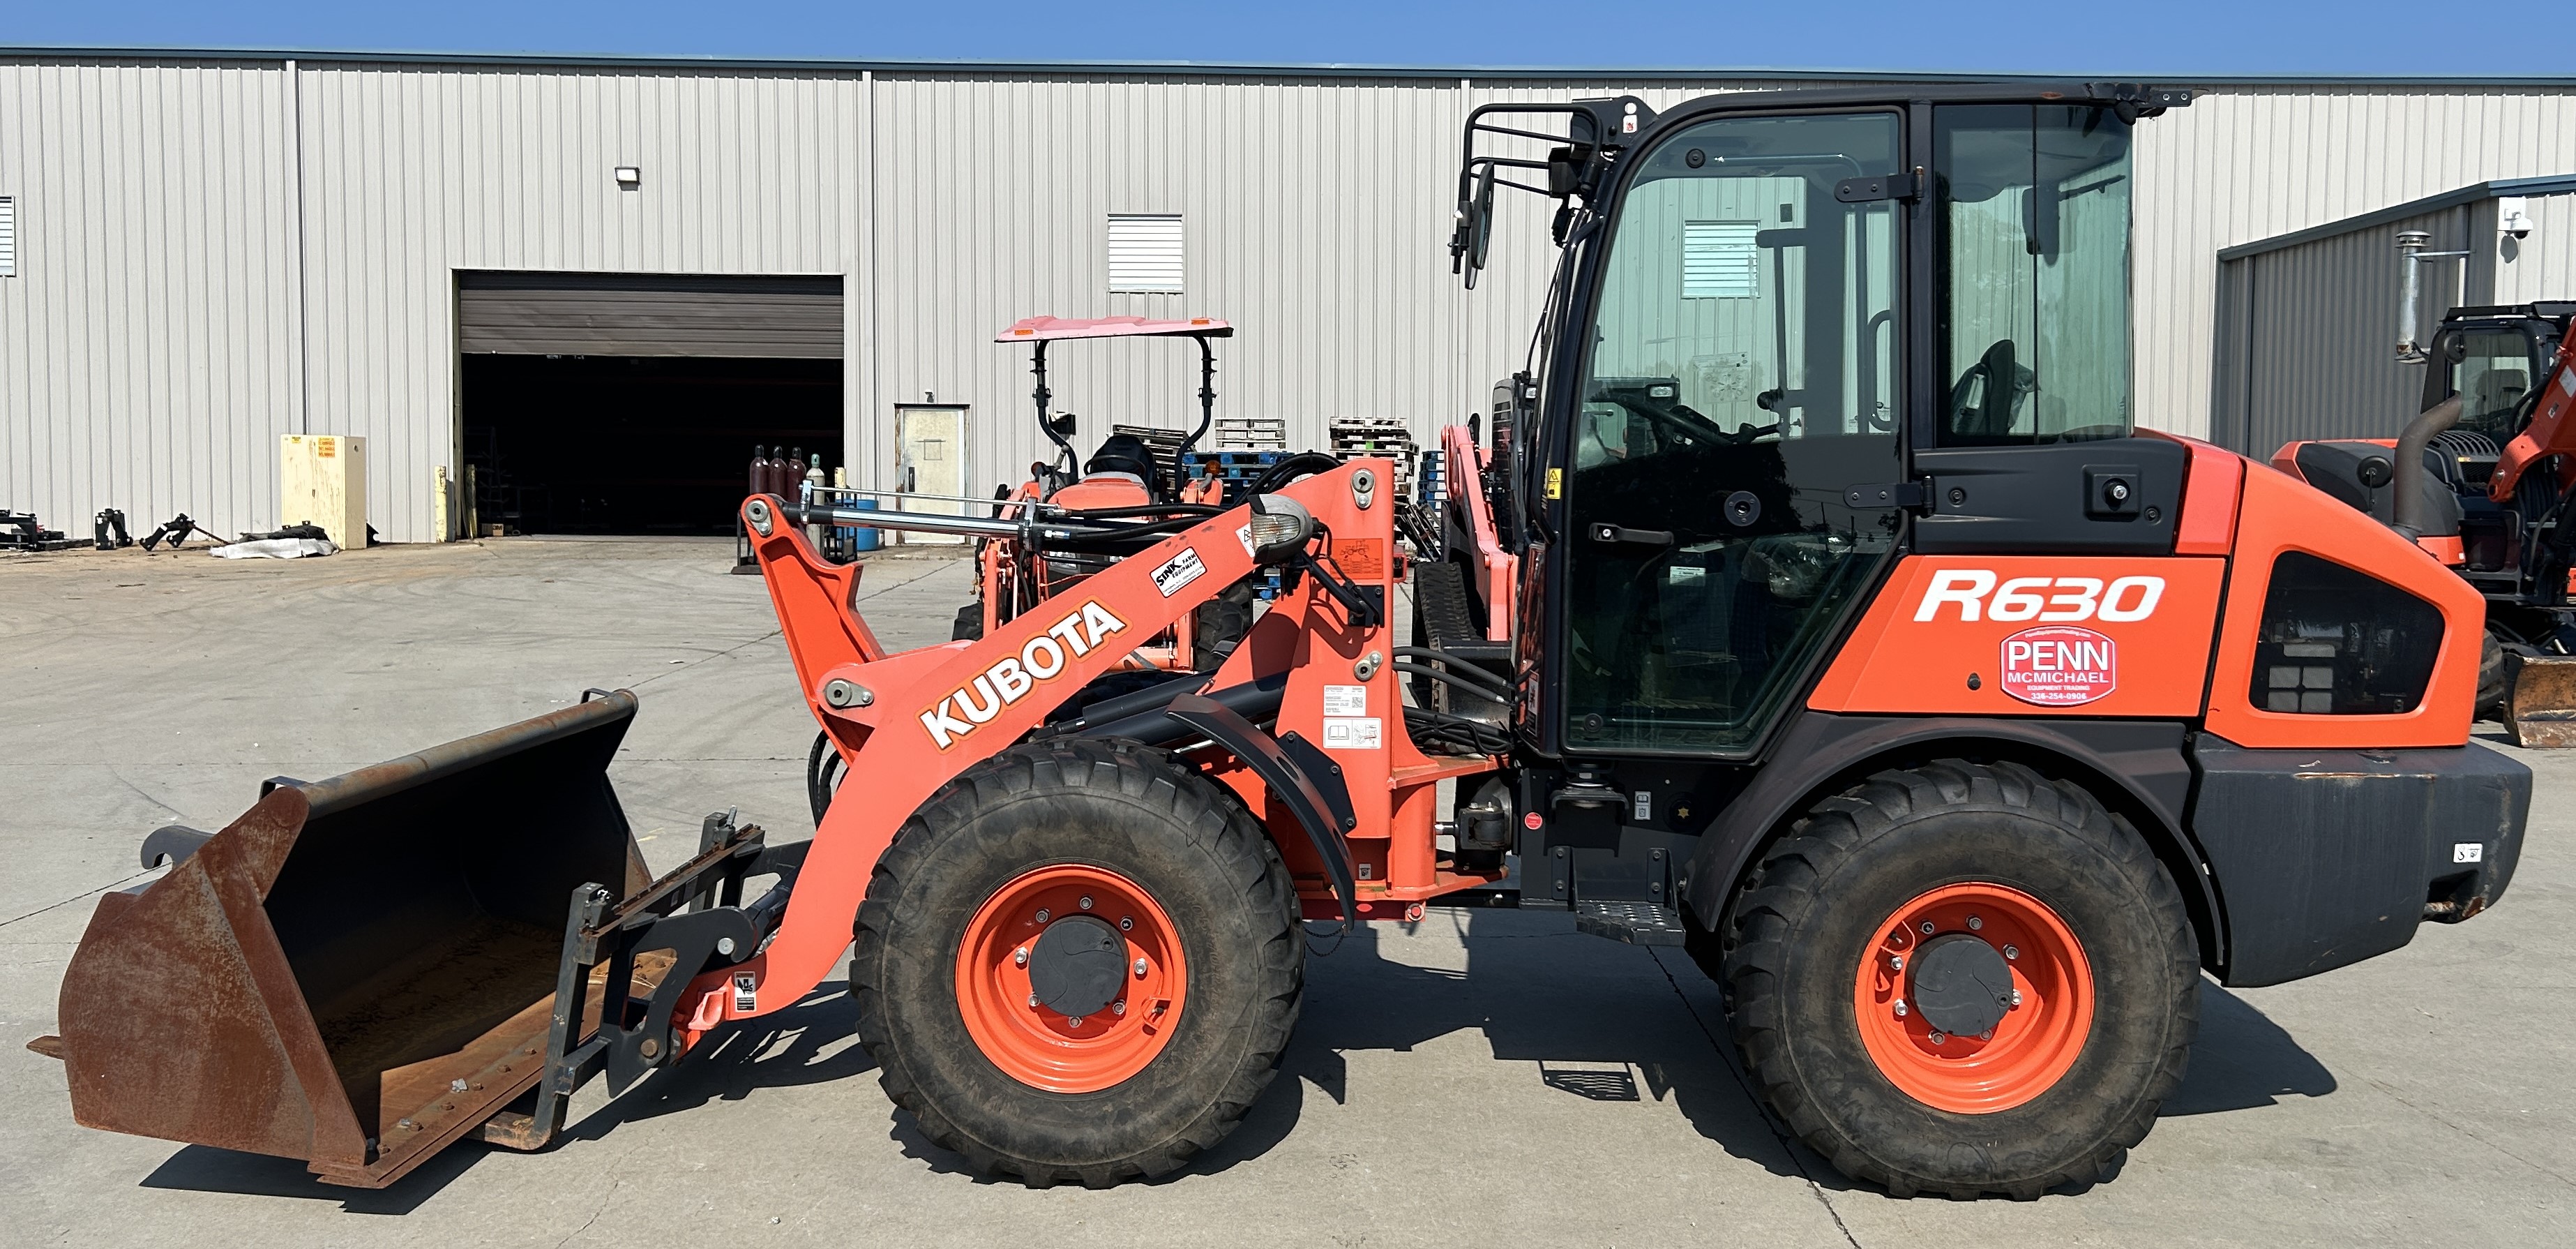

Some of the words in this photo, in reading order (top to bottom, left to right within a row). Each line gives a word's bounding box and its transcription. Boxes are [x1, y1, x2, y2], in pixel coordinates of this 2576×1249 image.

[1156, 558, 1183, 587] SINK
[1172, 558, 1198, 578] EQUIPMENT
[1182, 553, 1196, 564] FARM
[1913, 569, 2165, 622] R630
[2008, 641, 2109, 671] PENN
[919, 599, 1127, 750] KUBOTA
[2008, 672, 2109, 683] MCMICHAEL
